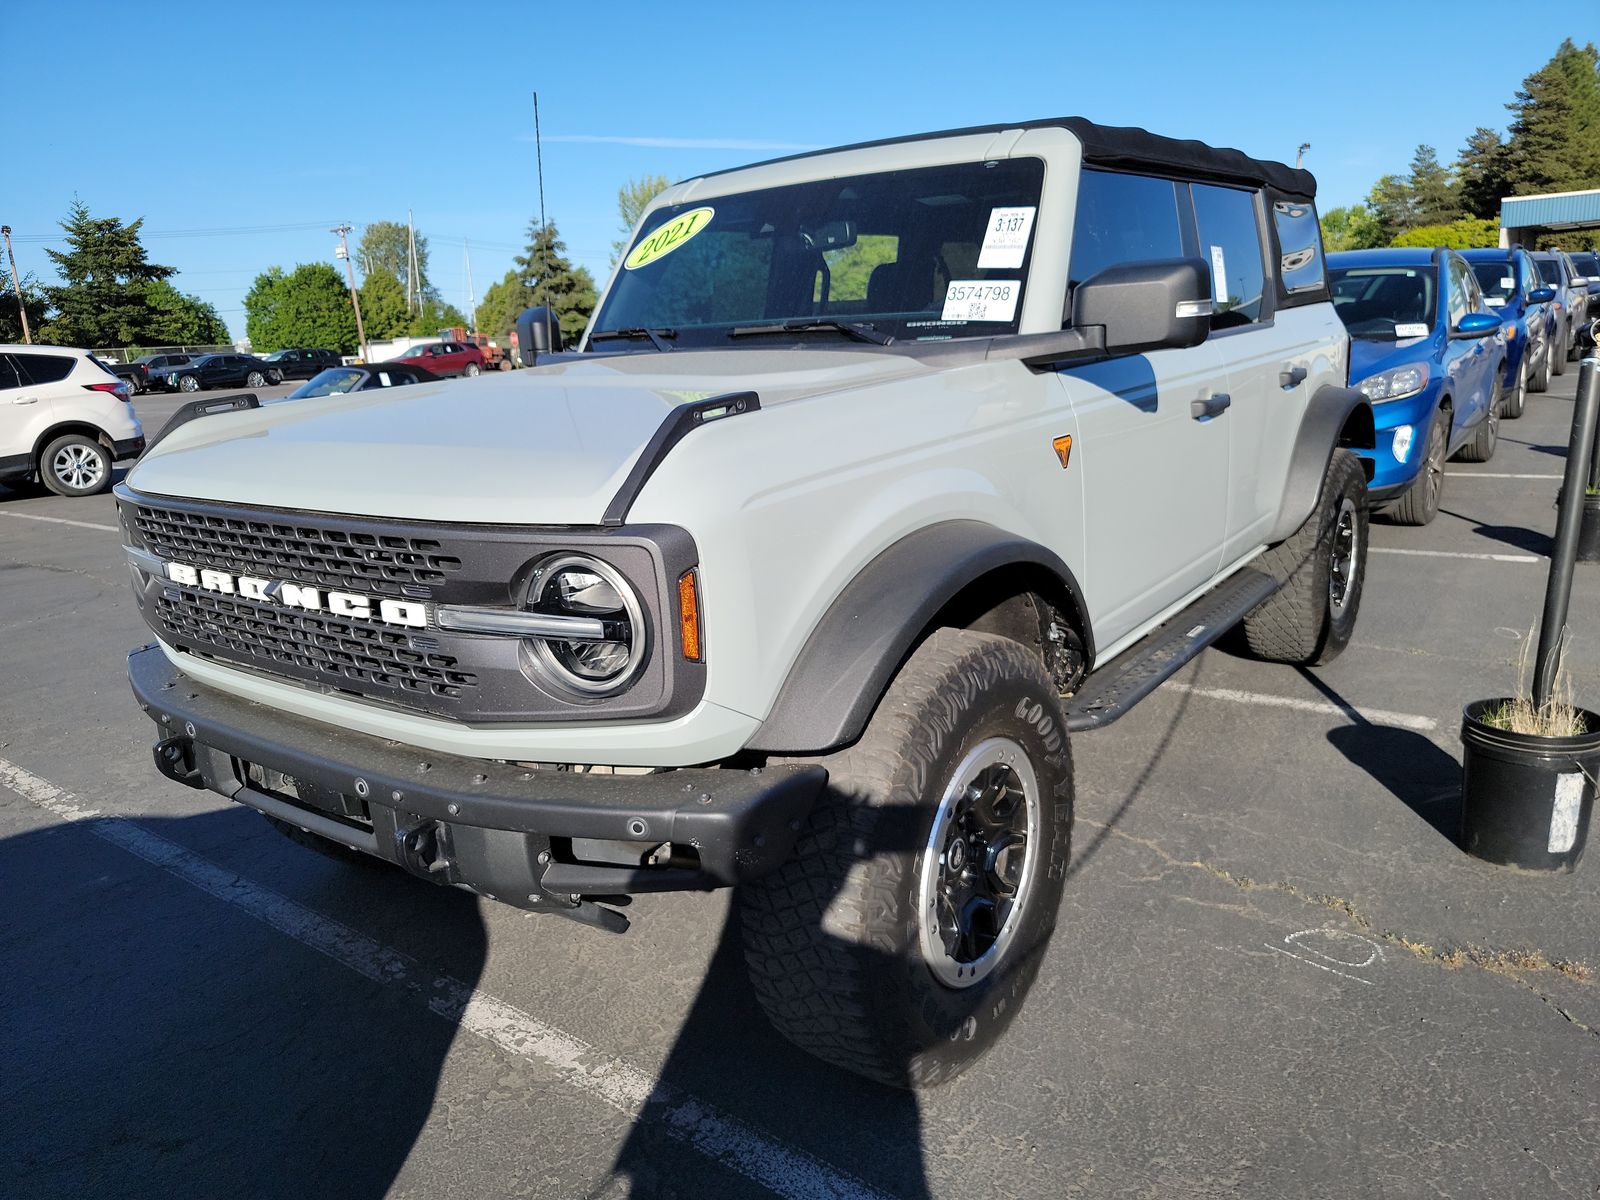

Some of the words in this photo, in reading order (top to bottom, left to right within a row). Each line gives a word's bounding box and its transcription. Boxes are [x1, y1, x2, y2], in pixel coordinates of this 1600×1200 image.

[637, 213, 700, 264] 2021
[947, 286, 1011, 301] 3574798
[168, 561, 428, 628] BRONCO
